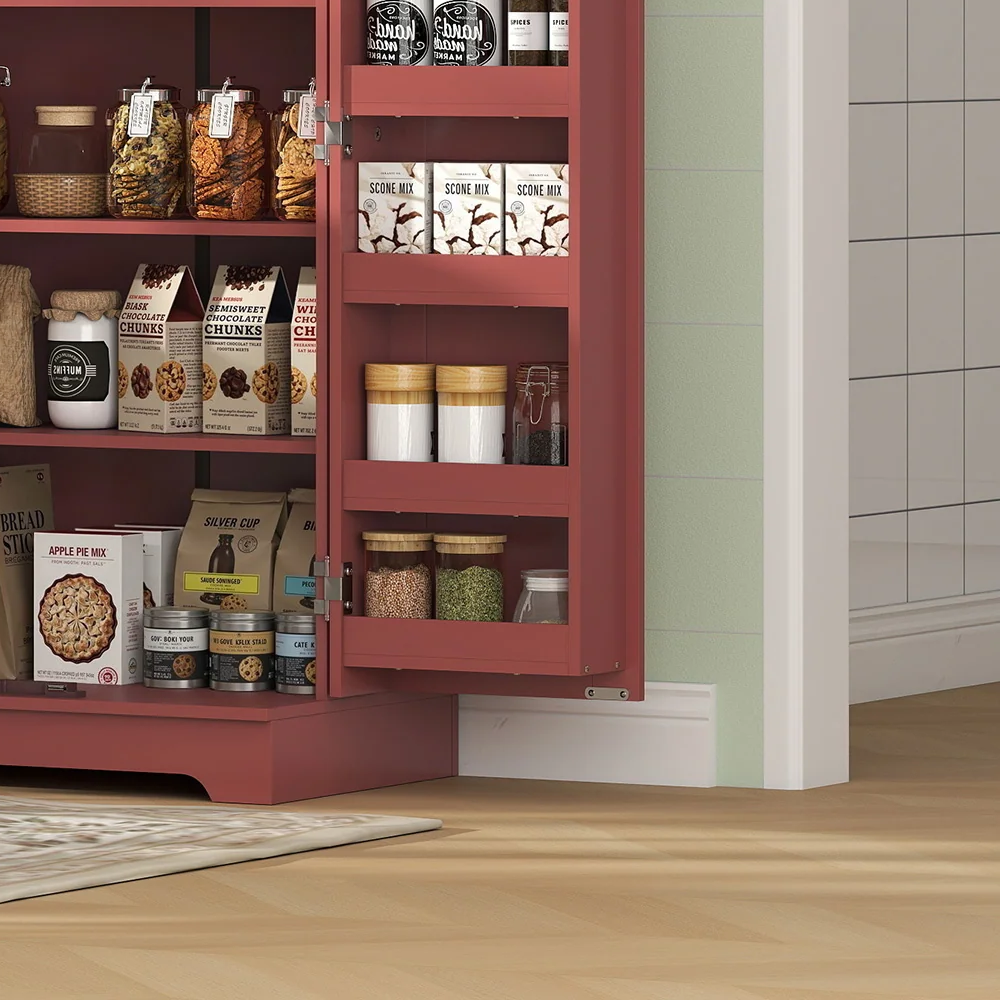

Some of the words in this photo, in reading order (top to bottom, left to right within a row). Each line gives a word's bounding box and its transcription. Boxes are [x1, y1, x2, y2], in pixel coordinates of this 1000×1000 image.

[369, 182, 396, 194] SCONE
[399, 182, 414, 194] MIX
[445, 183, 472, 195] SCONE
[474, 183, 490, 195] MIX
[517, 184, 544, 196] SCONE
[547, 185, 562, 196] MIX
[208, 304, 266, 313] SEMISWEET
[121, 312, 166, 321] CHOCOLATE
[206, 314, 263, 323] CHOCOLATE
[120, 322, 164, 334] CHUNKS
[204, 323, 262, 336] CHUNKS
[0, 509, 45, 532] BREAD
[204, 517, 238, 528] SILVER
[240, 518, 260, 528] CUP
[303, 520, 316, 531] BI
[49, 546, 74, 556] APPLE
[76, 547, 89, 557] PIE
[91, 547, 107, 558] MIX
[293, 641, 308, 649] CATE
